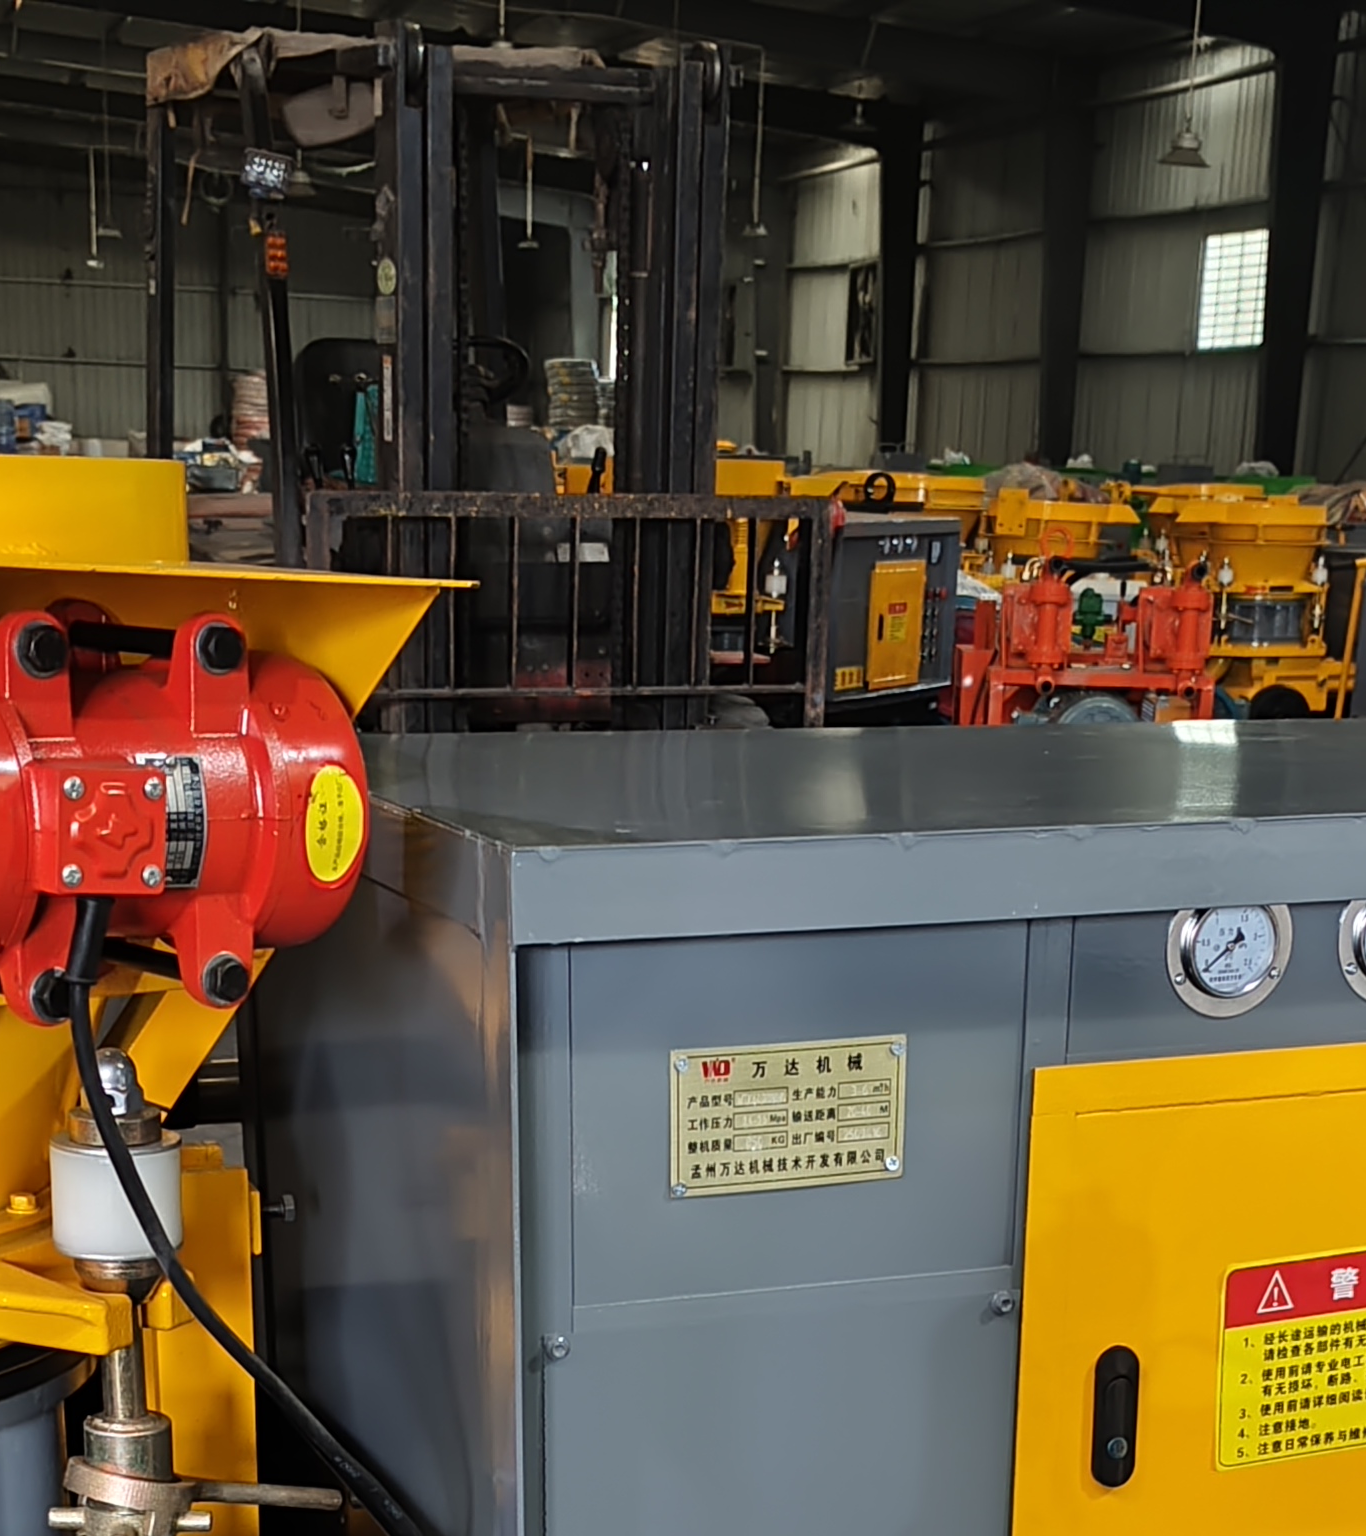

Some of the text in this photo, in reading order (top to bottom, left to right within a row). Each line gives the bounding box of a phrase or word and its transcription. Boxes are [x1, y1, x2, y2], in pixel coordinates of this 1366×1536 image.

[752, 1053, 863, 1078] 万达机械
[792, 1084, 837, 1100] 生产能力
[687, 1093, 734, 1109] 产品型号
[687, 1113, 733, 1131] 工作压力
[792, 1106, 837, 1123] 输送距离
[687, 1138, 733, 1154] 整机质量
[771, 1135, 785, 1145] KG
[792, 1128, 836, 1145] 出厂编号
[690, 1148, 886, 1180] 孟州万达机械技术开发有限公司
